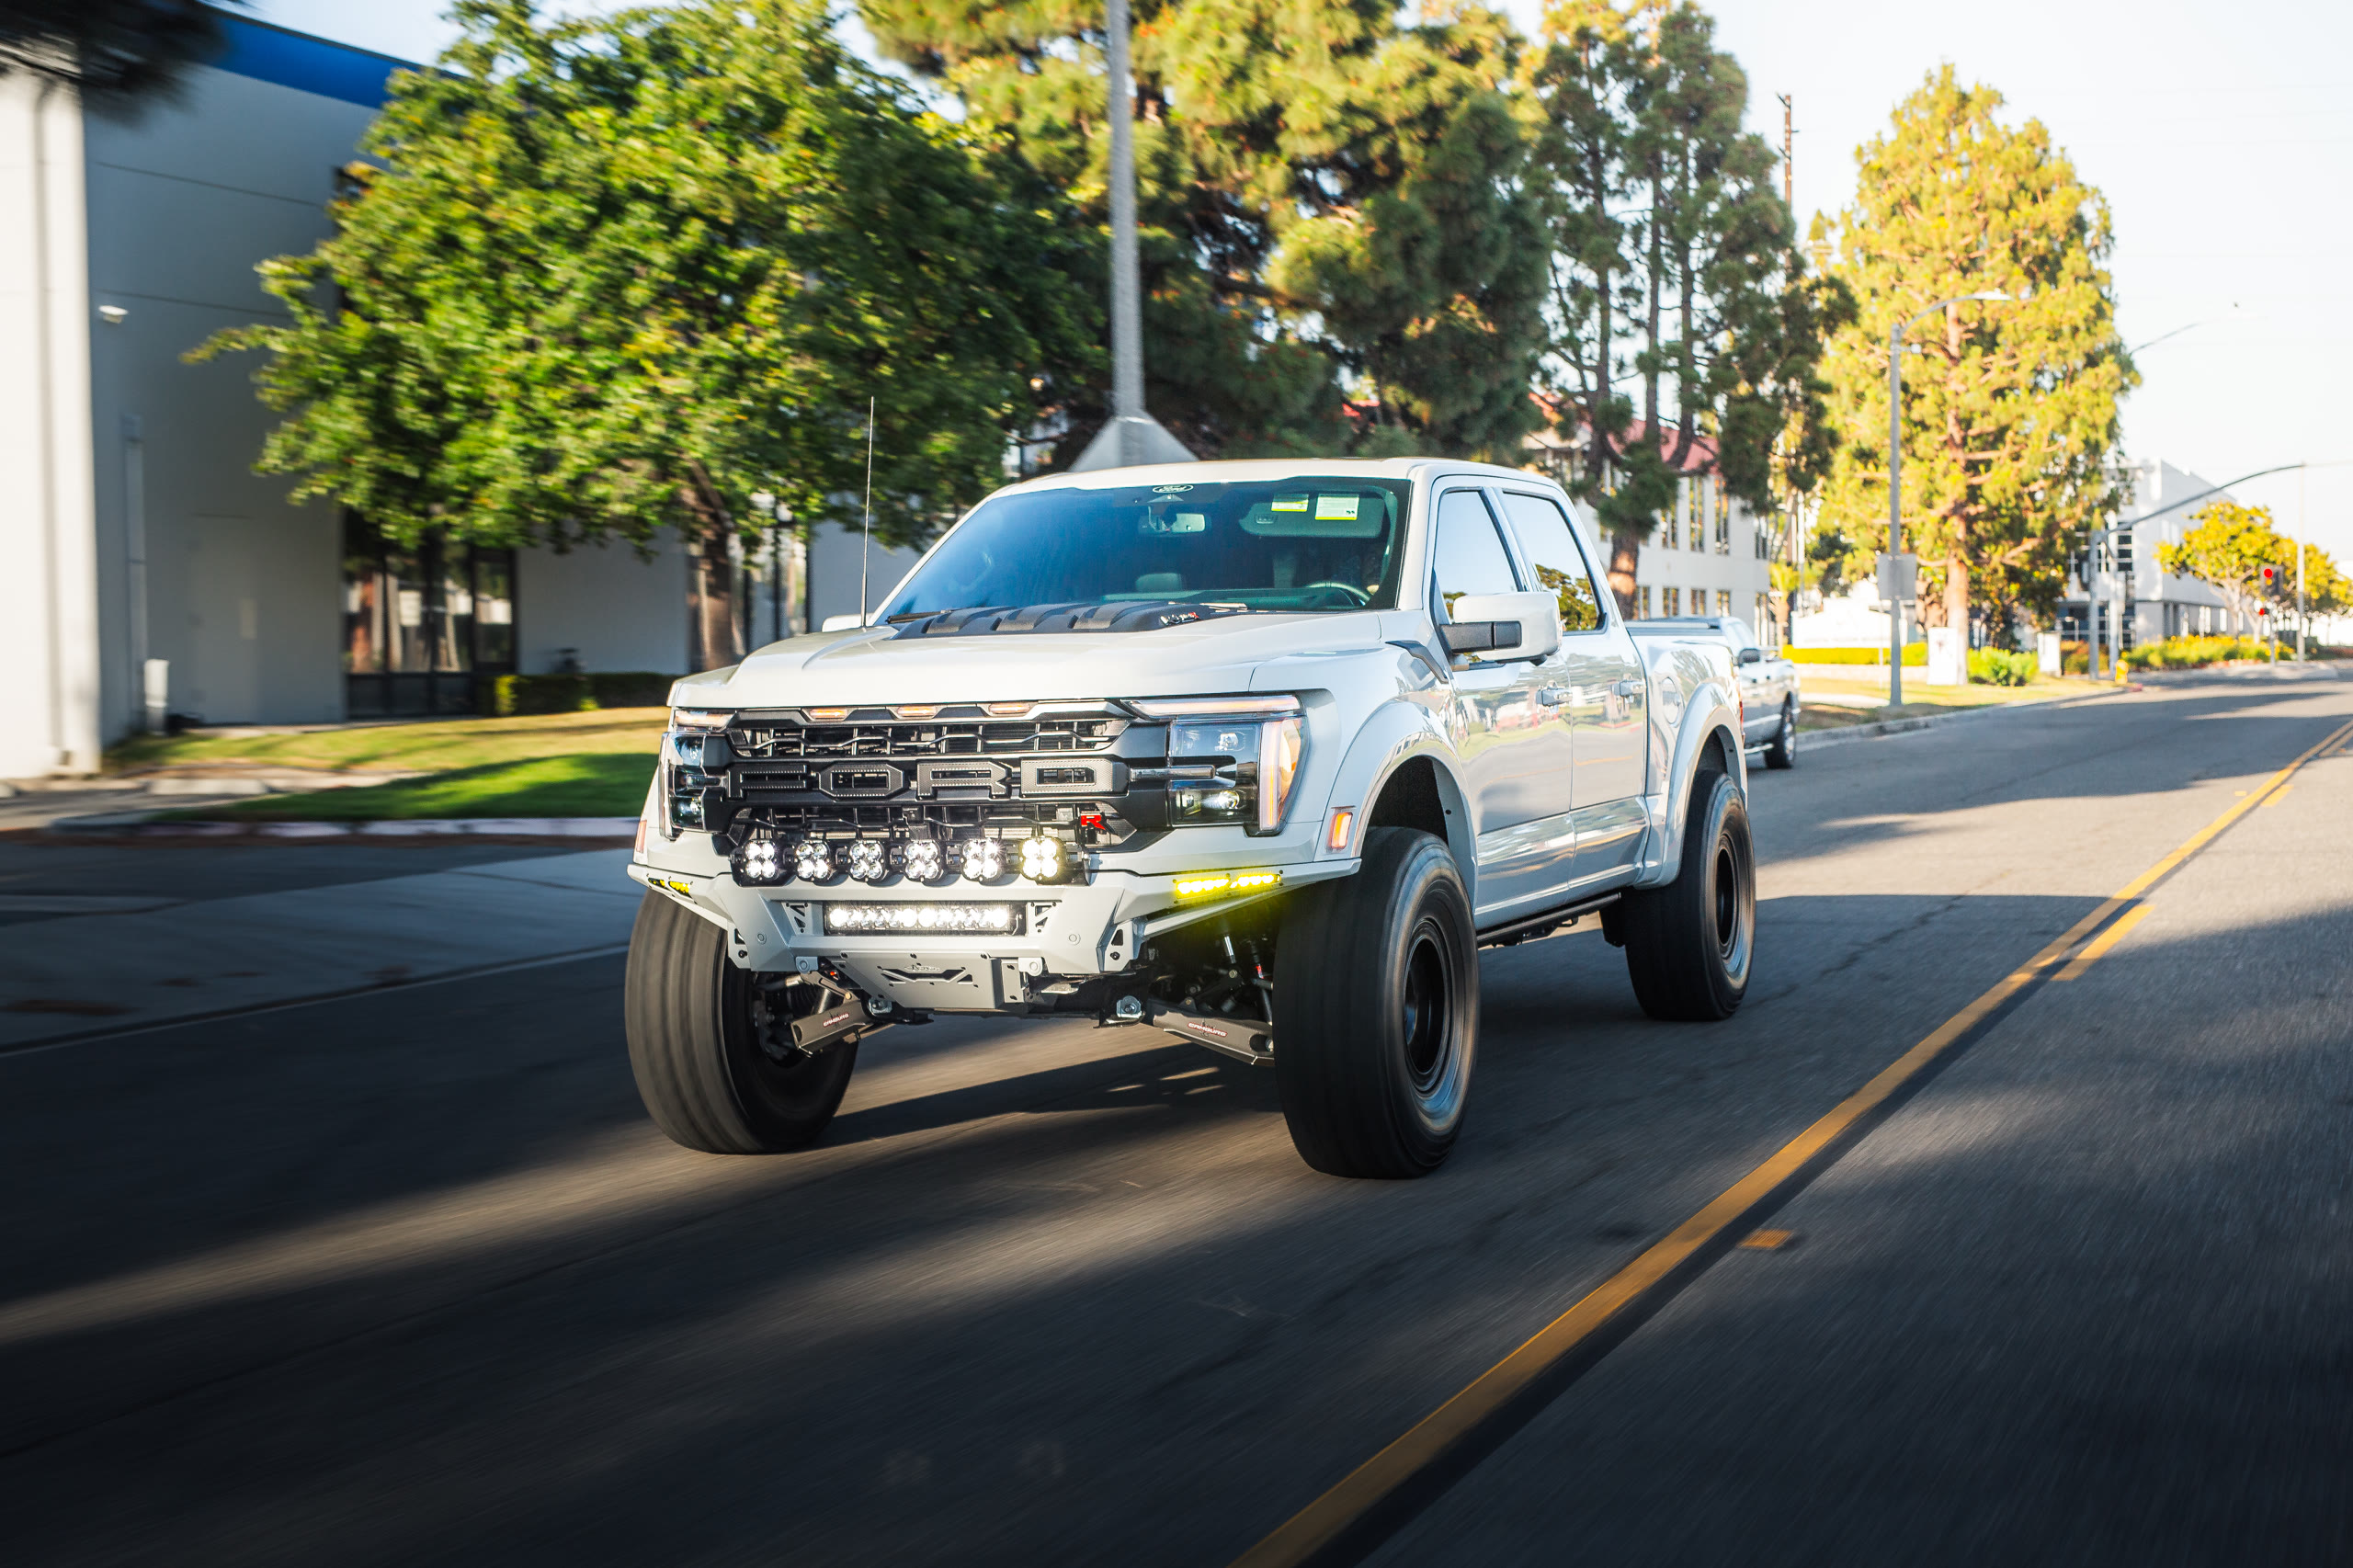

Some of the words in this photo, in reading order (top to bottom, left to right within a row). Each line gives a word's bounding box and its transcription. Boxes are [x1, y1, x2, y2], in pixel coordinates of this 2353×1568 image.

[727, 757, 1121, 799] FORD
[1080, 812, 1106, 830] R
[1188, 1022, 1227, 1037] CAMBURG
